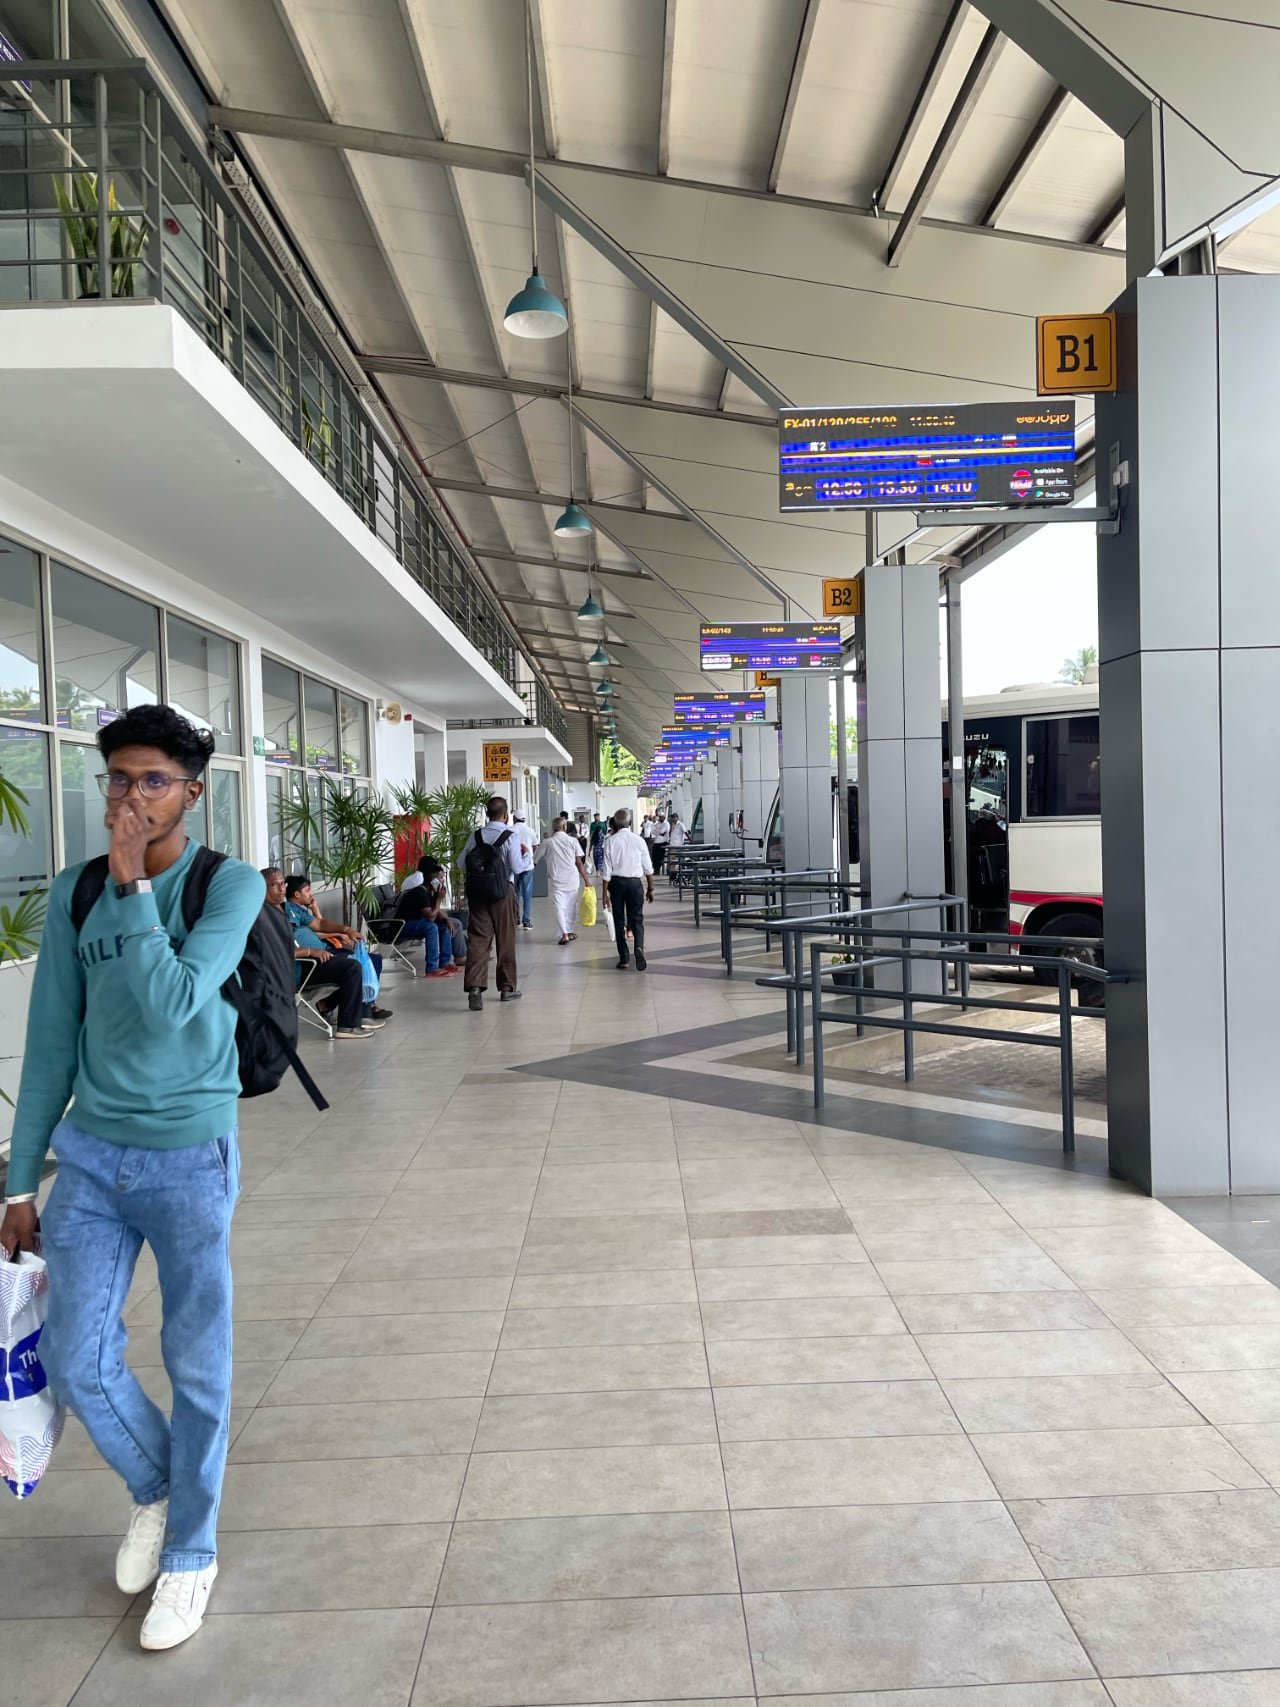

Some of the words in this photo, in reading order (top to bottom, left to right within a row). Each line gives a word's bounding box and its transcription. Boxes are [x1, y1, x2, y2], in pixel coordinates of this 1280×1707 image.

[1056, 333, 1098, 373] B1
[831, 588, 852, 606] B2
[965, 733, 989, 741] UZU
[76, 933, 124, 968] HILF
[19, 1349, 37, 1369] Th
